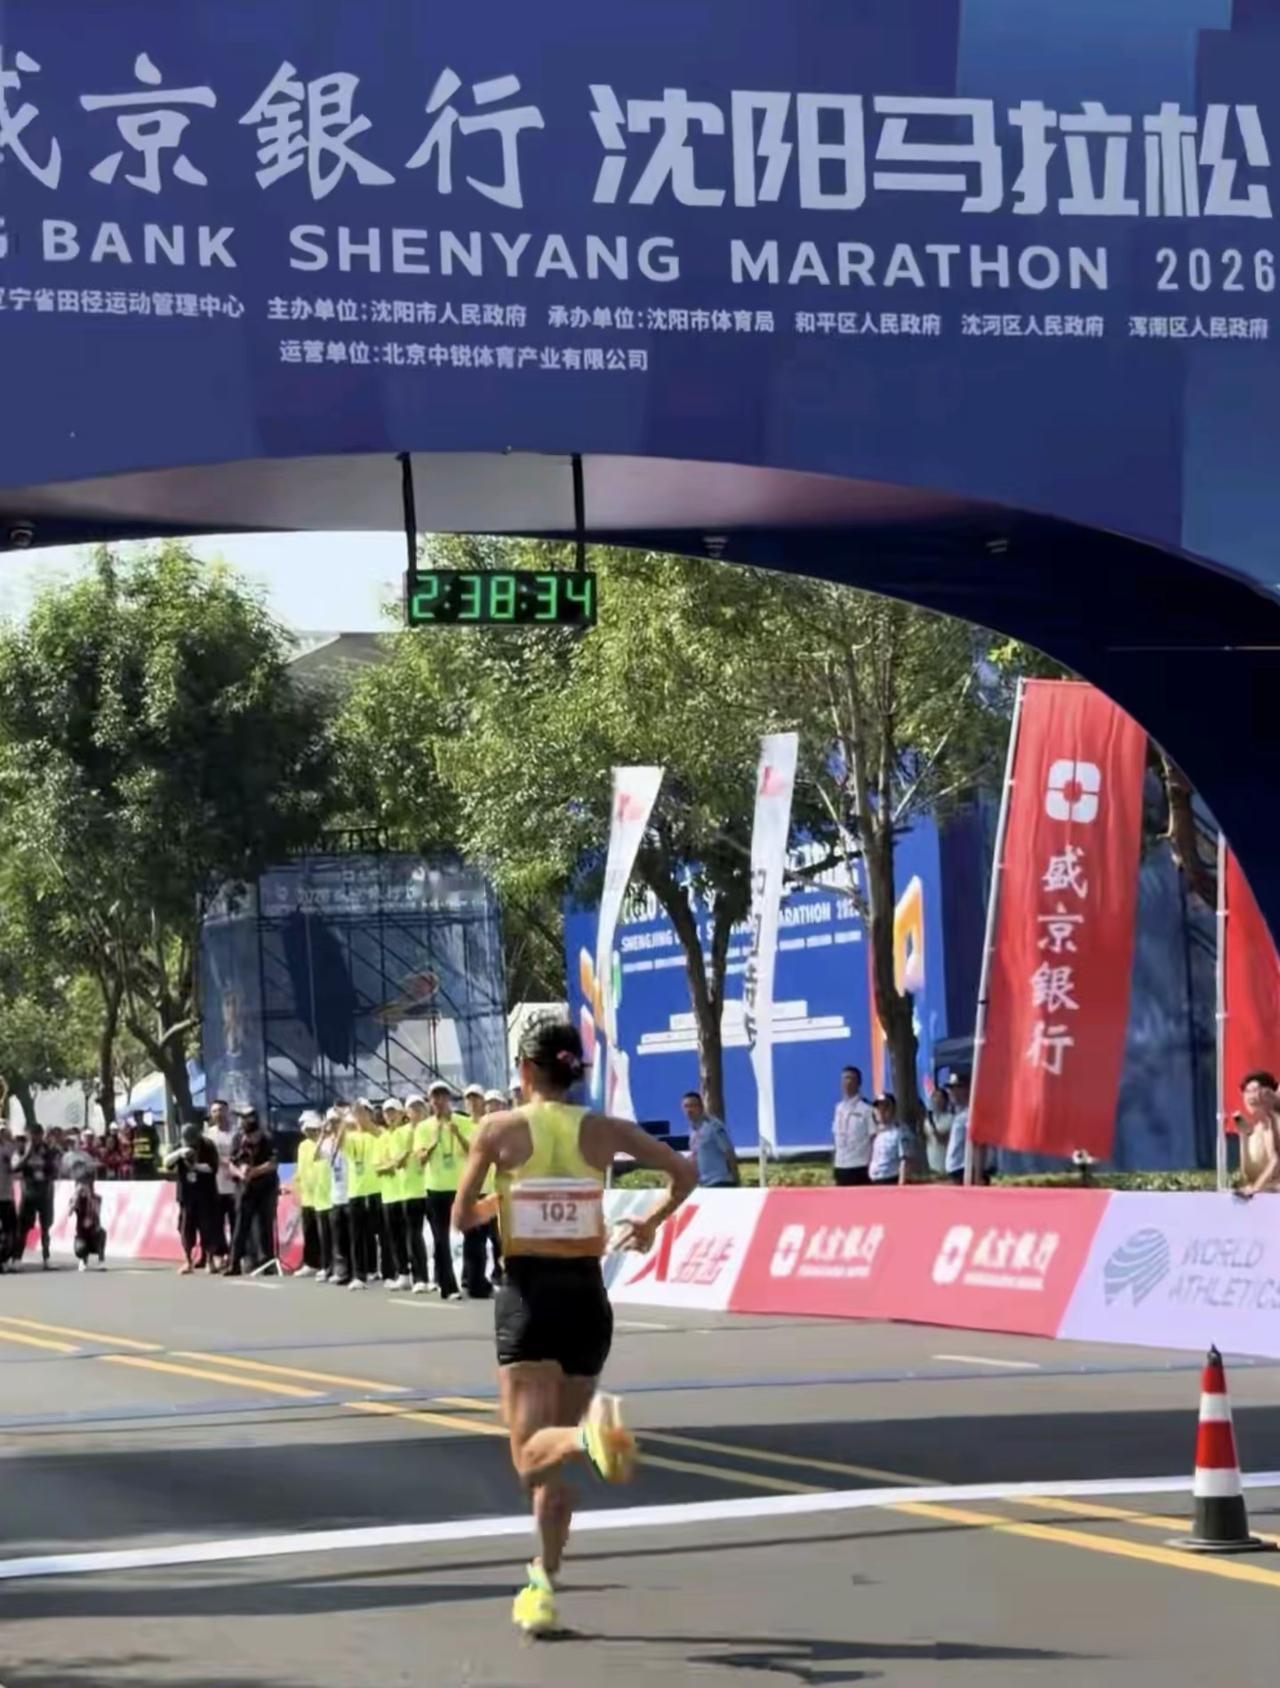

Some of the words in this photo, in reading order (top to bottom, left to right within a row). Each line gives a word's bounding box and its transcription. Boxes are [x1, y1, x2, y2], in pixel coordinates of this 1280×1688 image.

[589, 85, 1272, 218] 沈阳马拉松
[43, 220, 237, 267] BANK
[290, 225, 680, 281] SHENYANG
[731, 240, 1107, 290] MARATHON
[1157, 248, 1275, 292] 2026
[0, 287, 244, 317] 宁省田径运动管理中心
[795, 311, 941, 335] 和平区人民政府
[962, 314, 1104, 337] 沈河区人民政府
[412, 575, 591, 620] 2:38:34
[541, 1202, 578, 1222] 102
